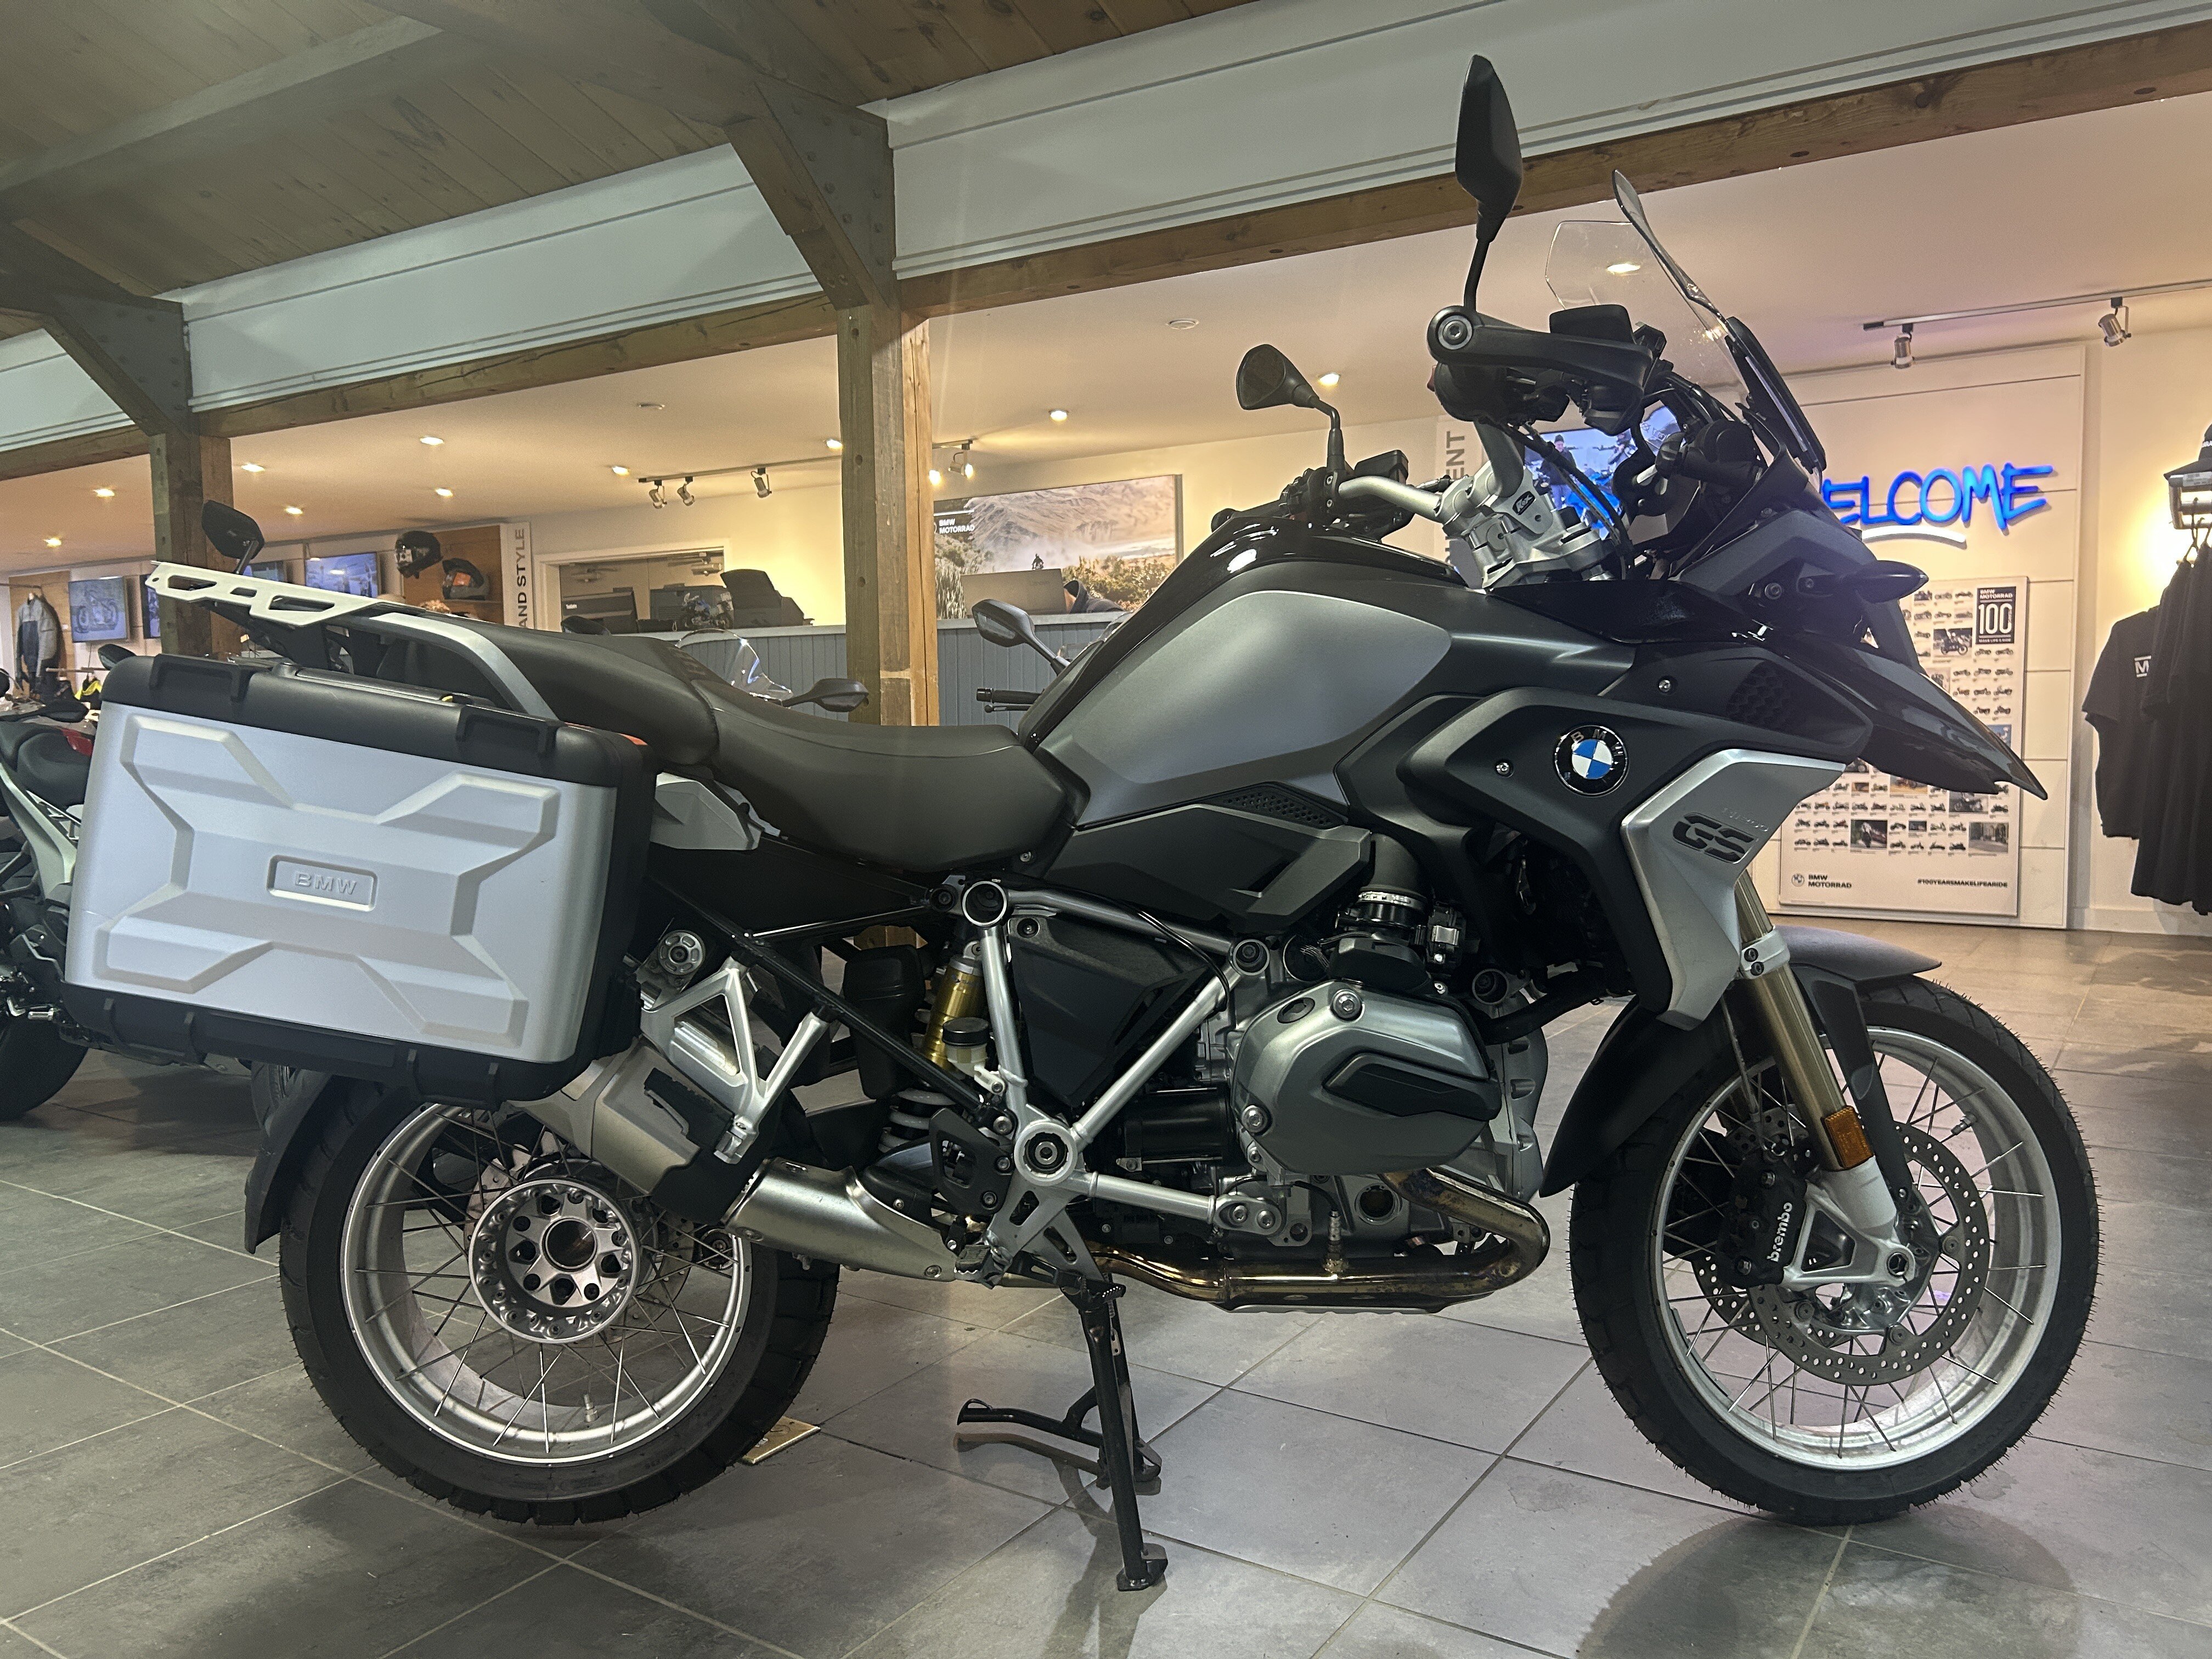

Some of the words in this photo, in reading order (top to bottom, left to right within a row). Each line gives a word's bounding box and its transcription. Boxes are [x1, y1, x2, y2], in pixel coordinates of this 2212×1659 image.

[1446, 431, 1465, 479] ENT
[1822, 462, 2053, 529] ELCOME
[939, 518, 956, 527] BMW
[939, 524, 975, 534] MOTORRAD
[515, 529, 526, 587] STYLE
[518, 592, 527, 627] AND
[1978, 603, 2012, 634] 100
[1570, 729, 1624, 757] BMW
[1672, 812, 1757, 862] GS
[295, 872, 357, 895] BMW
[1767, 1202, 1793, 1262] brembo
